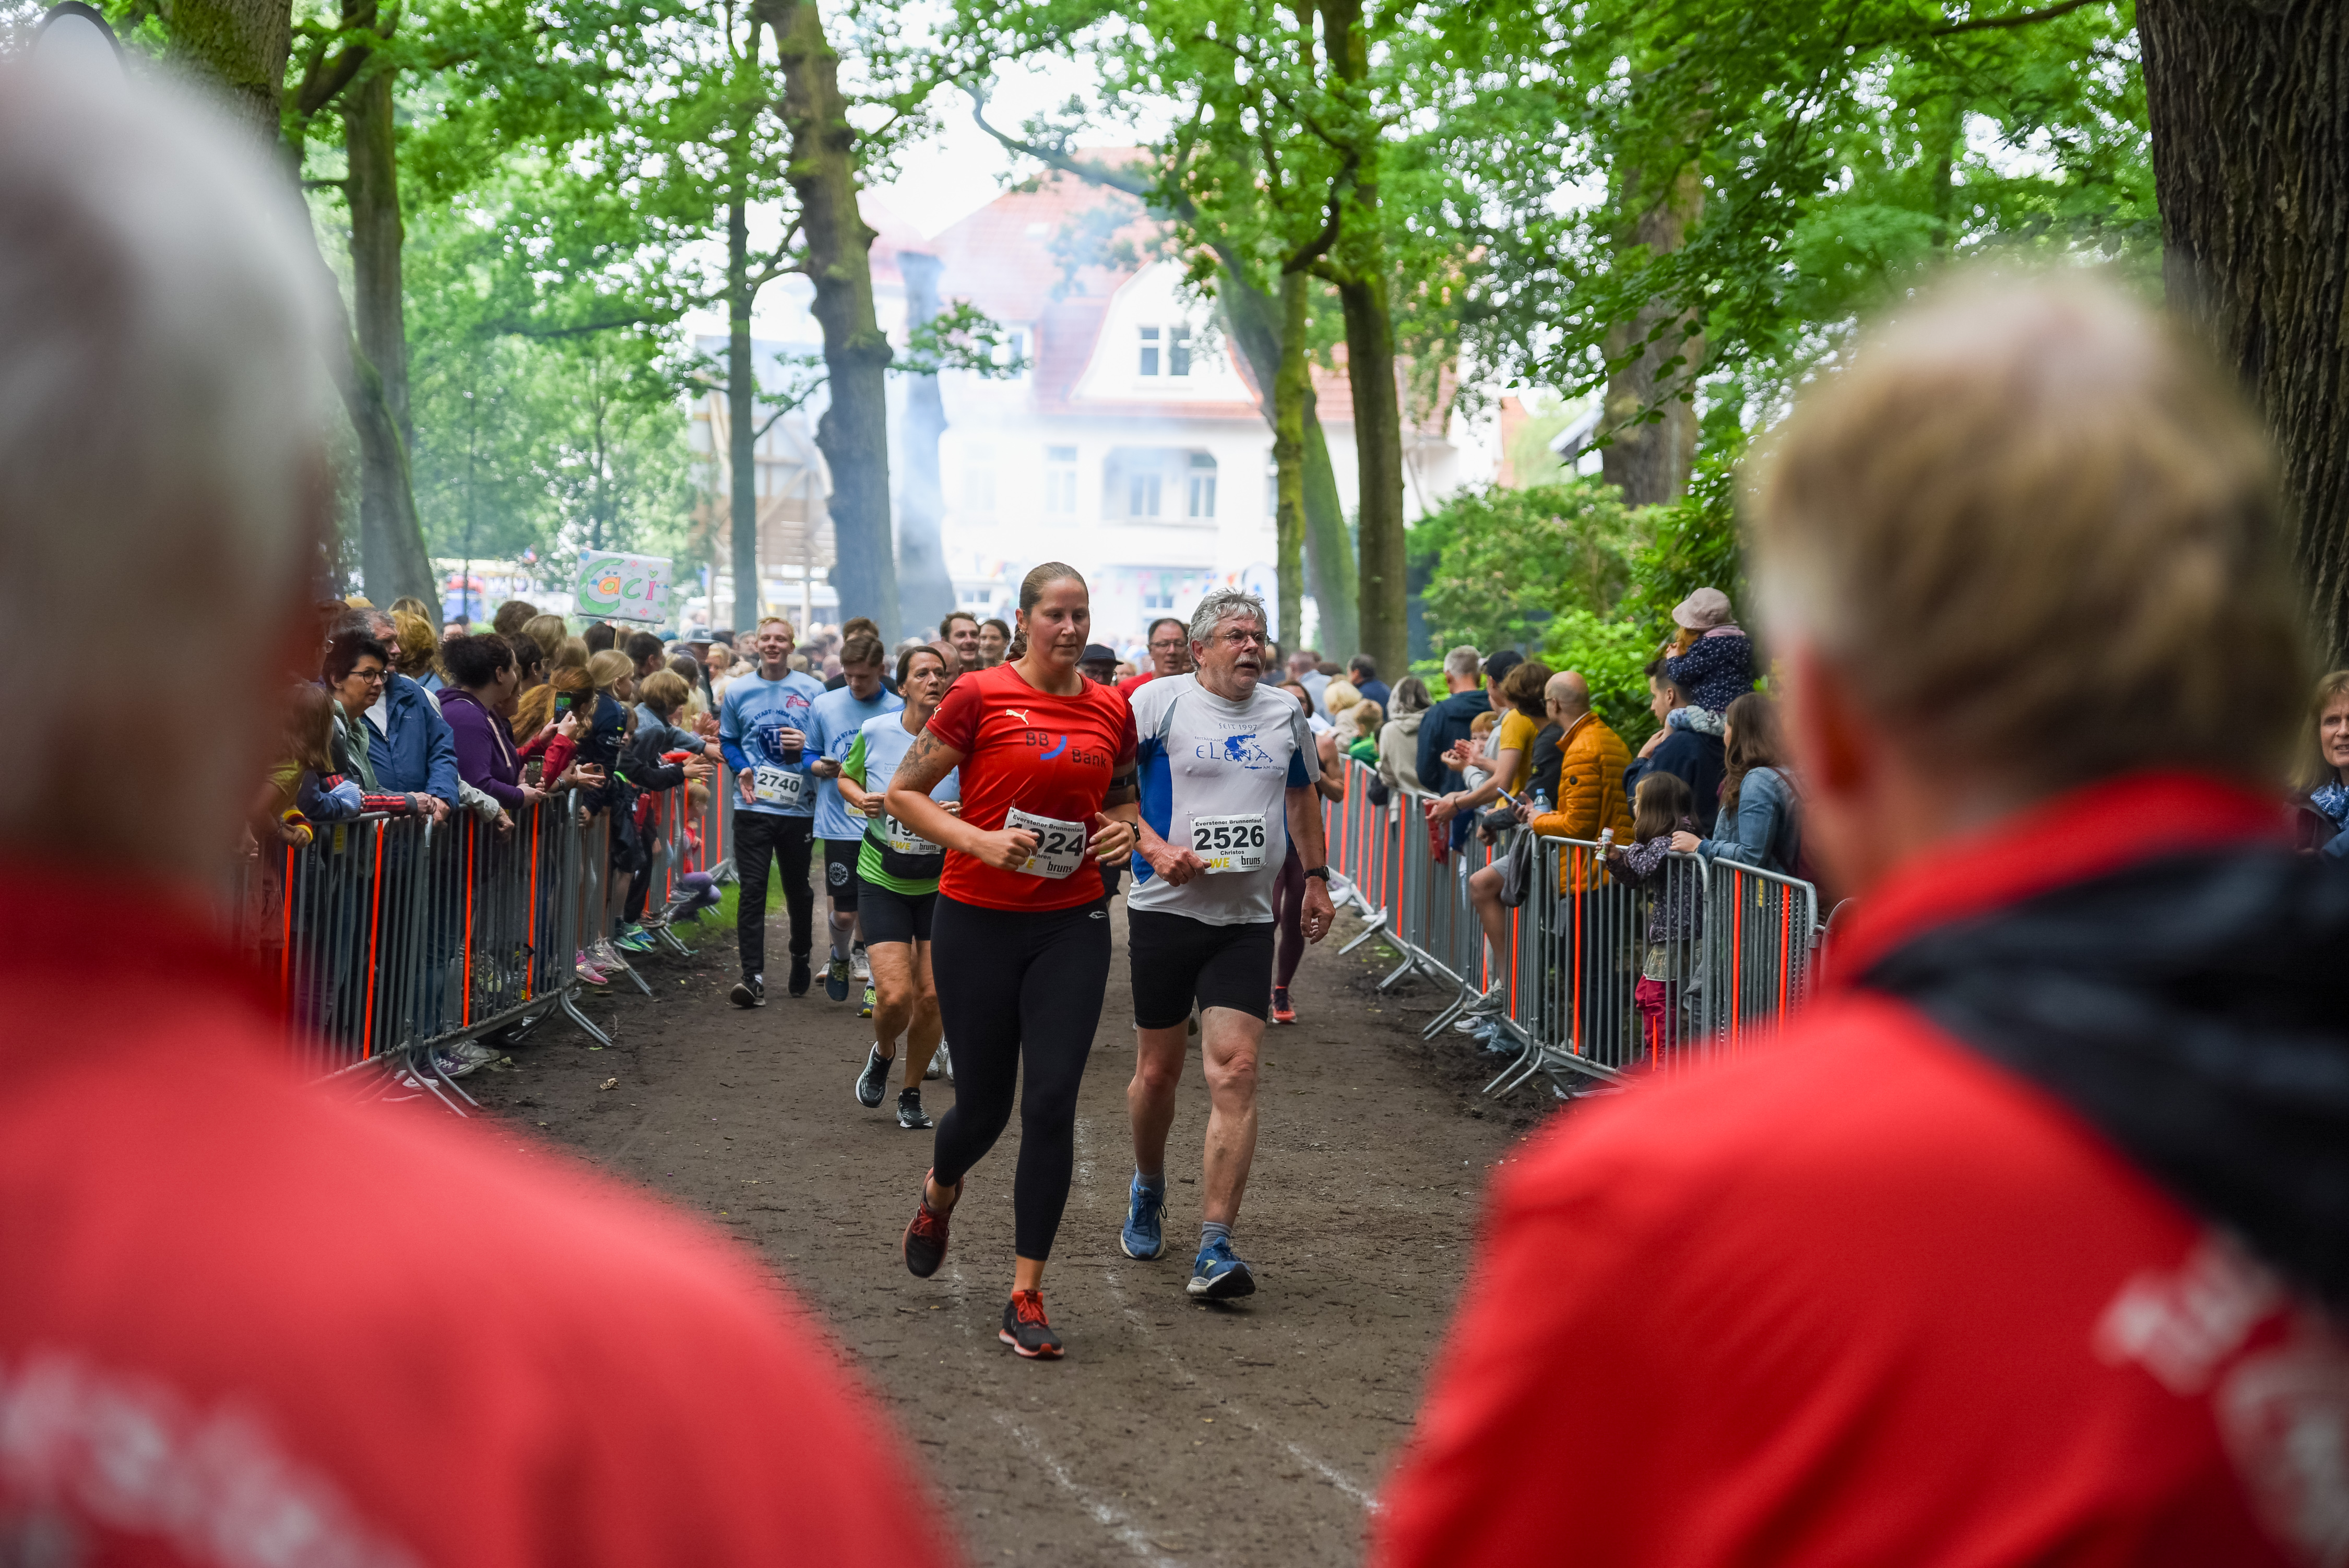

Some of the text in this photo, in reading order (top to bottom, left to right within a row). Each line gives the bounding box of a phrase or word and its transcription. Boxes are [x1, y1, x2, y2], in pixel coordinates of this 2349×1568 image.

[1026, 731, 1049, 746] BB
[1072, 749, 1106, 768] Bank
[1196, 742, 1273, 763] ELENA
[757, 773, 800, 792] 2740
[1013, 814, 1085, 833] Everstener Brunnenlauf
[891, 840, 911, 850] EWE
[1009, 823, 1084, 857] 924
[1194, 825, 1265, 851] 2526
[1047, 861, 1073, 873] bruns
[1205, 856, 1260, 869] WE bruns
